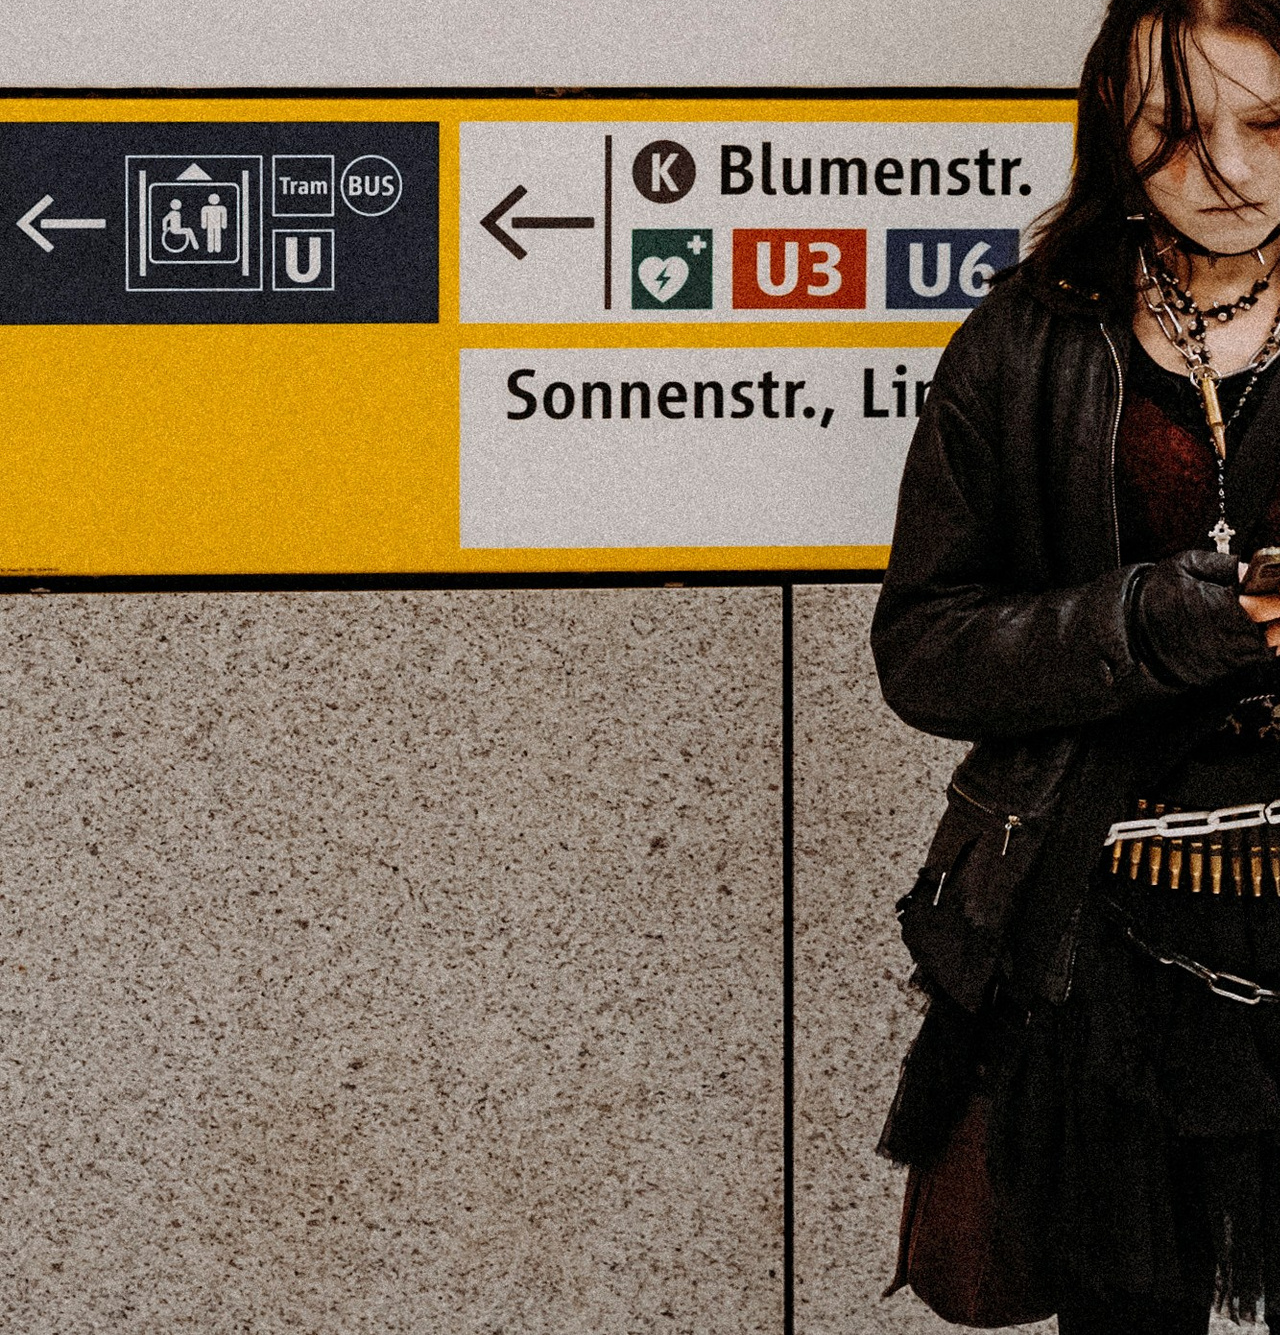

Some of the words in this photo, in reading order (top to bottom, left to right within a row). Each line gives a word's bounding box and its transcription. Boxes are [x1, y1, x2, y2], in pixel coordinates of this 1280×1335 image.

[278, 176, 329, 195] Tram
[348, 174, 395, 197] BUS
[651, 152, 680, 193] K
[720, 141, 1033, 197] Blumenstr.
[285, 236, 322, 284] U
[756, 241, 843, 297] U3
[908, 241, 995, 298] U6
[507, 368, 835, 429] Sonnenstr.,
